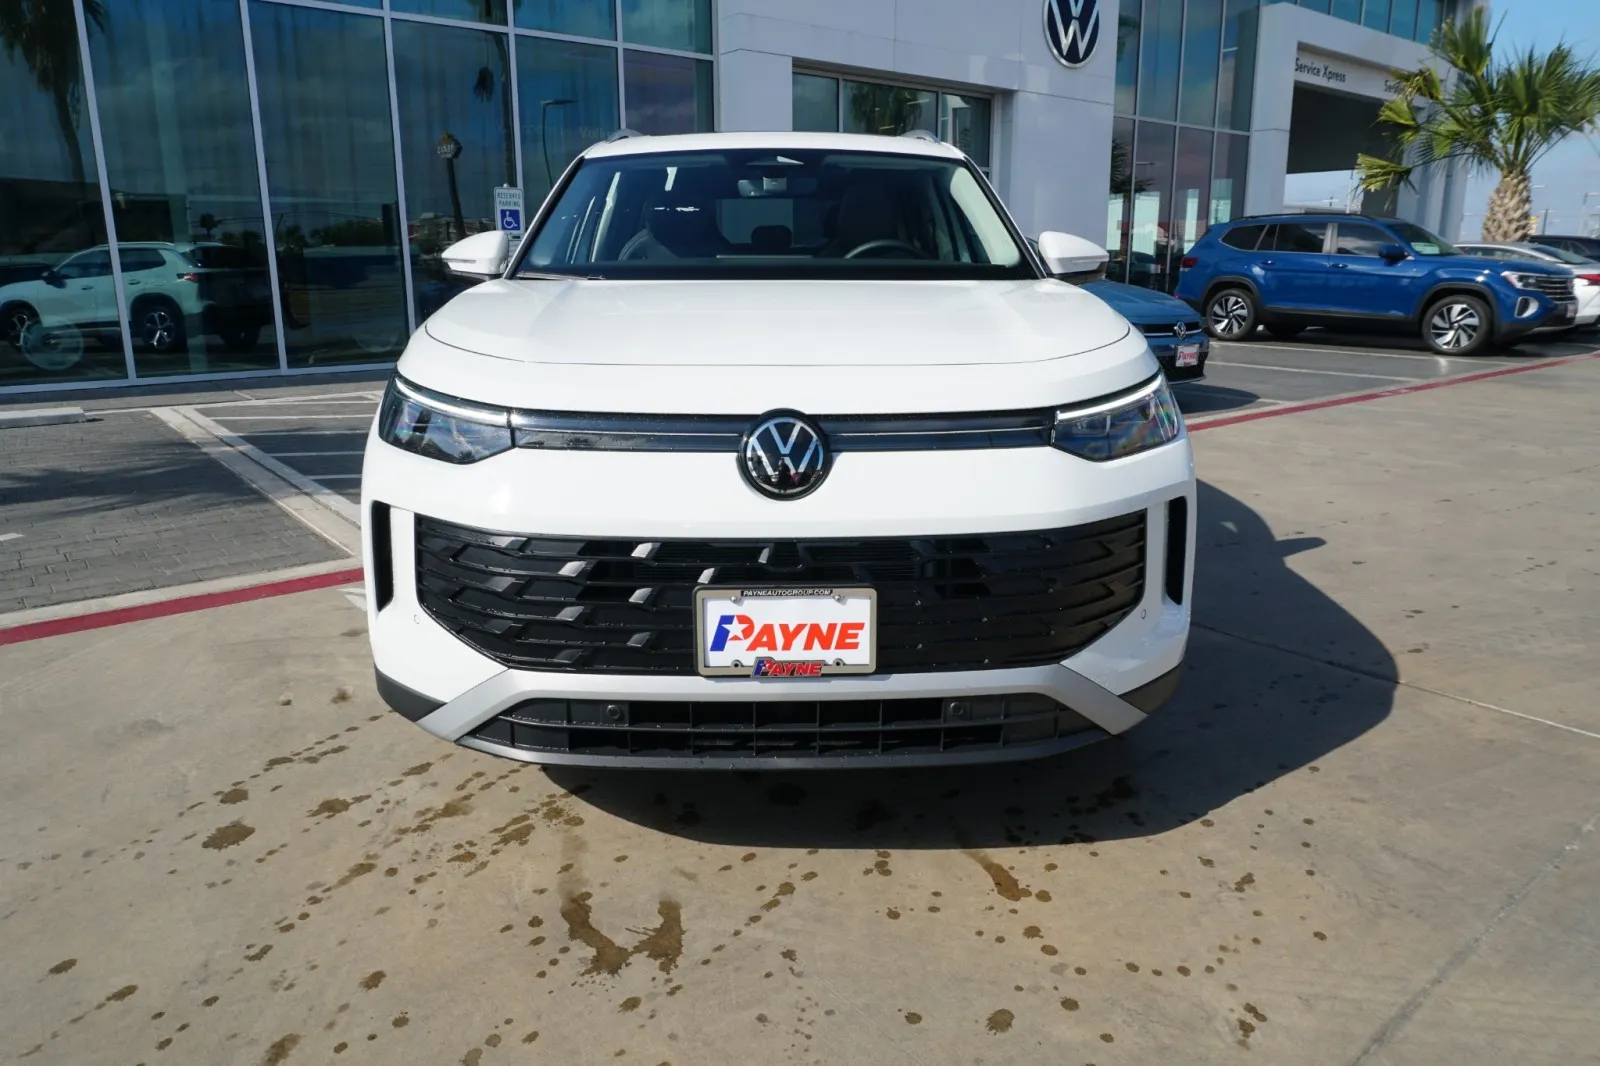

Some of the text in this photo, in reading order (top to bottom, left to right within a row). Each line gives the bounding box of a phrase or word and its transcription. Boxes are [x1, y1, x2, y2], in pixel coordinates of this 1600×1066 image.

[1295, 57, 1346, 83] Service Xpress
[743, 589, 832, 597] PAYNEAUTOGROUP.COM
[709, 614, 866, 652] PAYNE
[753, 658, 822, 677] PAYNE
